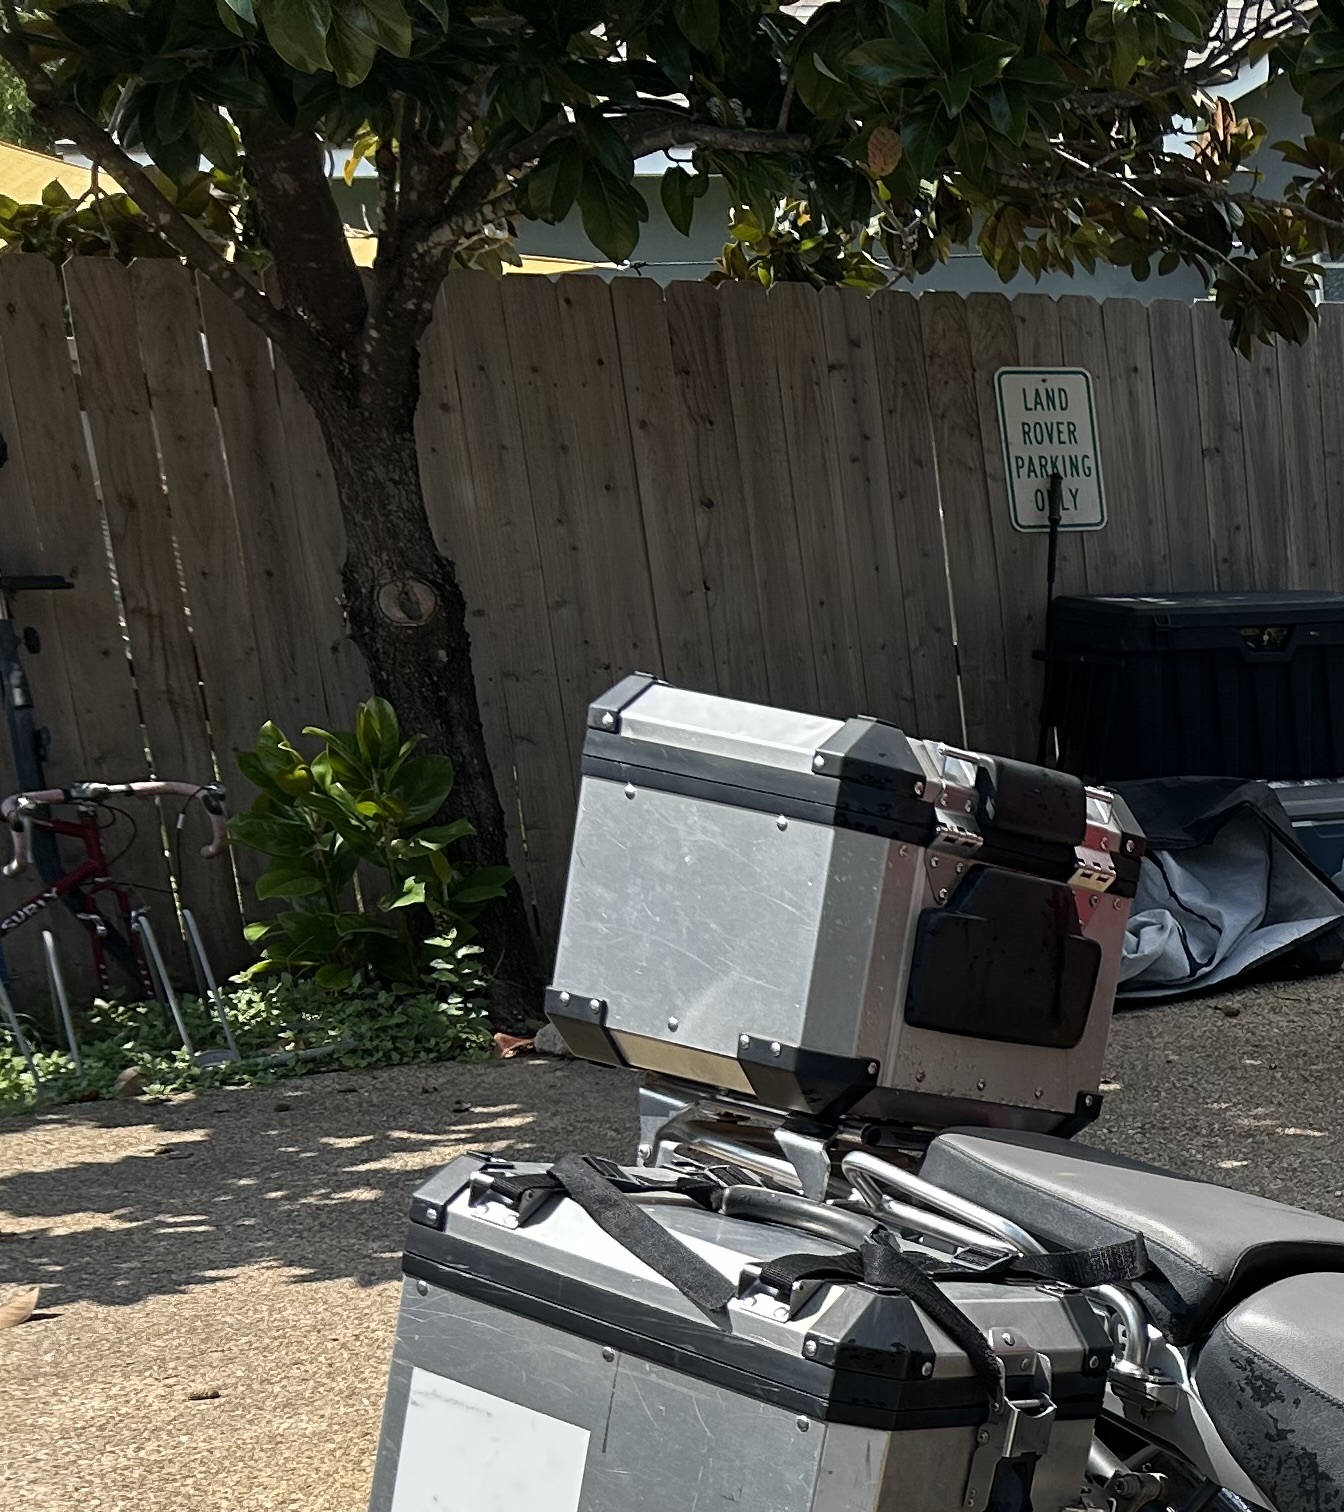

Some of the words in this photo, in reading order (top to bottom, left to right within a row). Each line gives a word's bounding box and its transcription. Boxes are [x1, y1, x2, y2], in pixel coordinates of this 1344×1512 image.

[1022, 388, 1069, 411] LAND
[1021, 421, 1078, 445] ROVER
[1014, 454, 1093, 479] PARKING
[1034, 488, 1079, 512] OLY
[1, 887, 58, 929] SURLY
